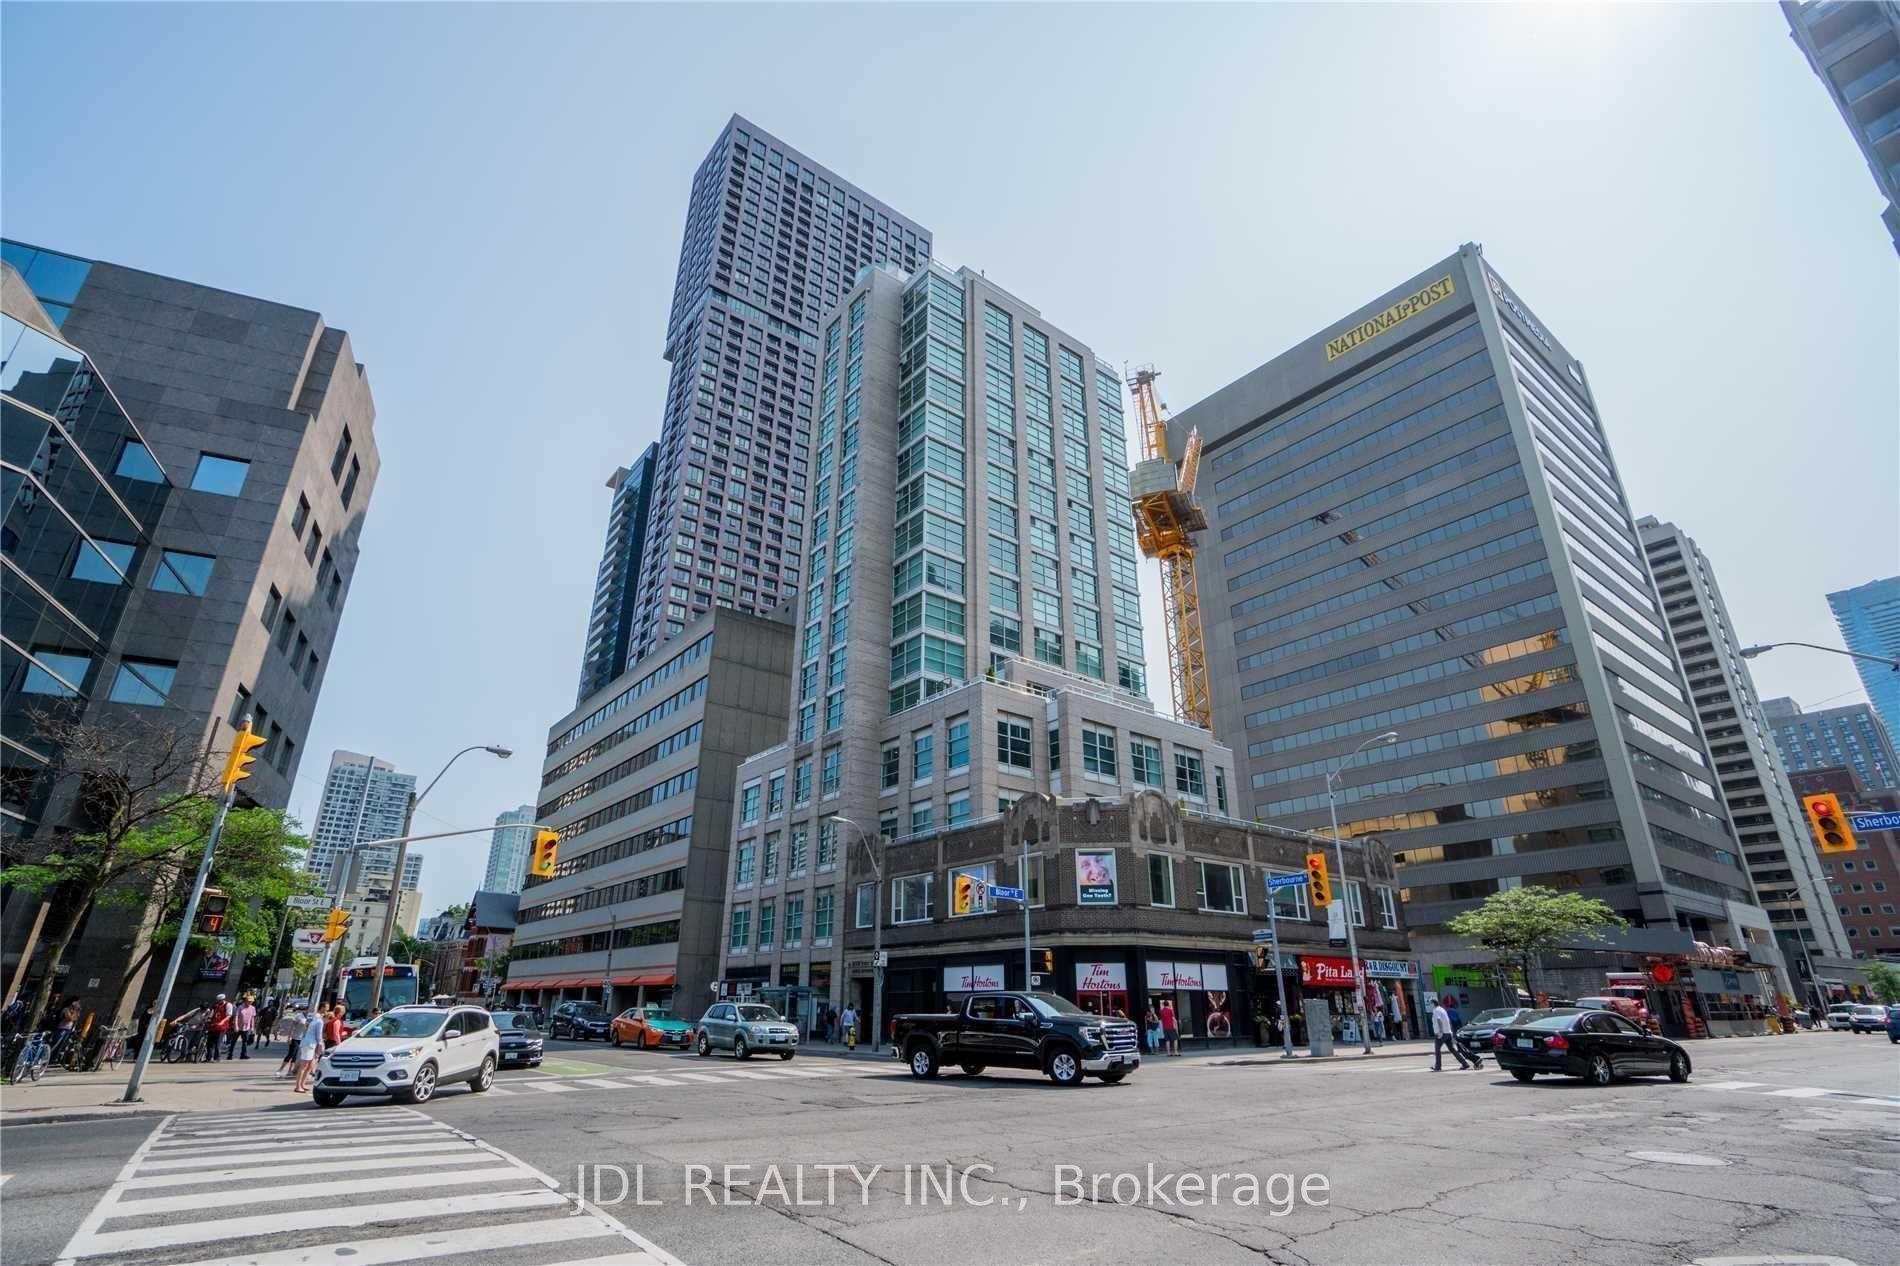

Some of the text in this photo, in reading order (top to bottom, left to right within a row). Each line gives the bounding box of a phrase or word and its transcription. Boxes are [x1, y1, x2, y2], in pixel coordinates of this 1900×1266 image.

[1327, 277, 1451, 359] NATIONAL POST
[1856, 815, 1900, 829] Sherbo
[1268, 875, 1304, 886] Sherbourne
[995, 887, 1010, 897] Bloor
[293, 896, 311, 905] Bloor
[210, 916, 219, 931] 4
[1090, 964, 1109, 977] Tim
[1315, 962, 1364, 980] Pita Lad
[961, 975, 999, 989] Tim Hortons
[1082, 976, 1121, 991] Hortons
[1160, 972, 1202, 987] Tim Hortons
